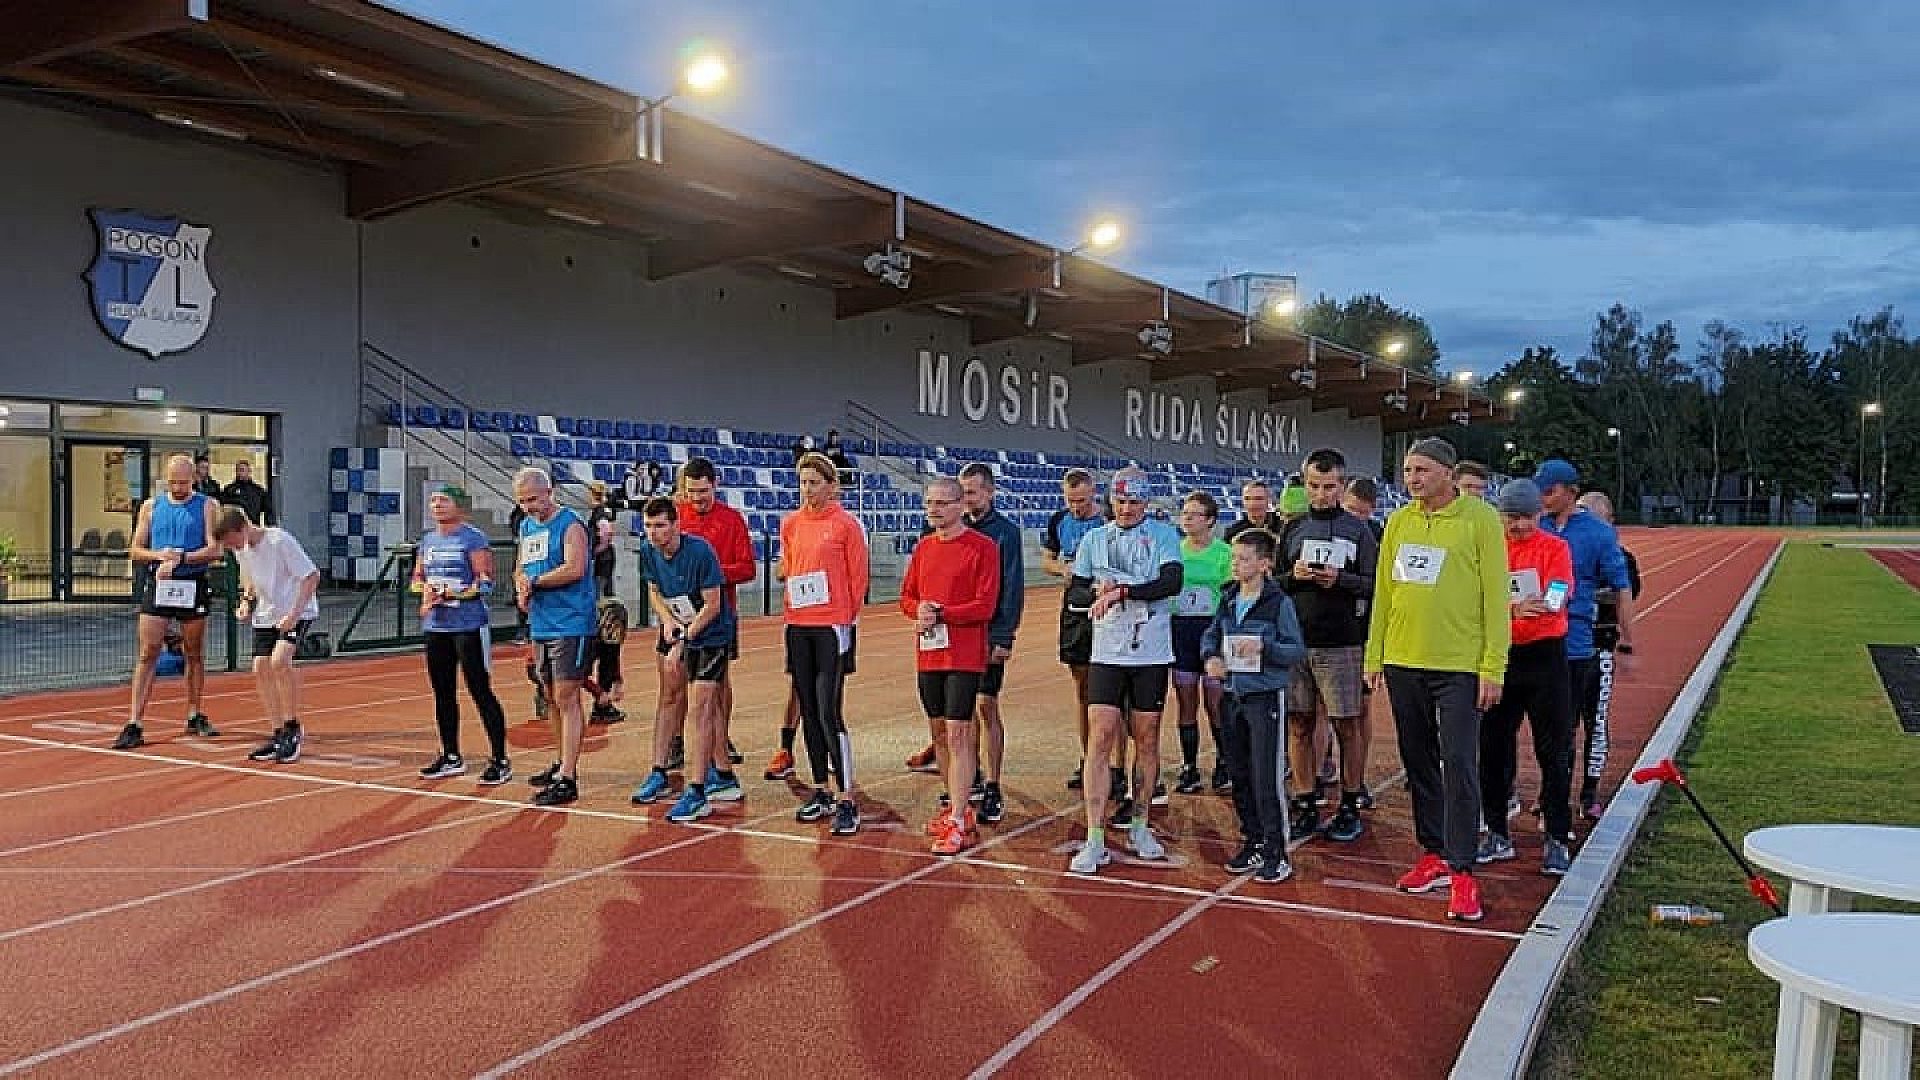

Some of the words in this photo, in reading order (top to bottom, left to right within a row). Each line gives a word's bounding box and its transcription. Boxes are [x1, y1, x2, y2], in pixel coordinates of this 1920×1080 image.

[175, 265, 199, 309] L
[918, 351, 1070, 431] MOSiR
[1125, 387, 1204, 445] RUDA
[1215, 391, 1300, 461] ŚLĄSKA
[1407, 554, 1429, 569] 22
